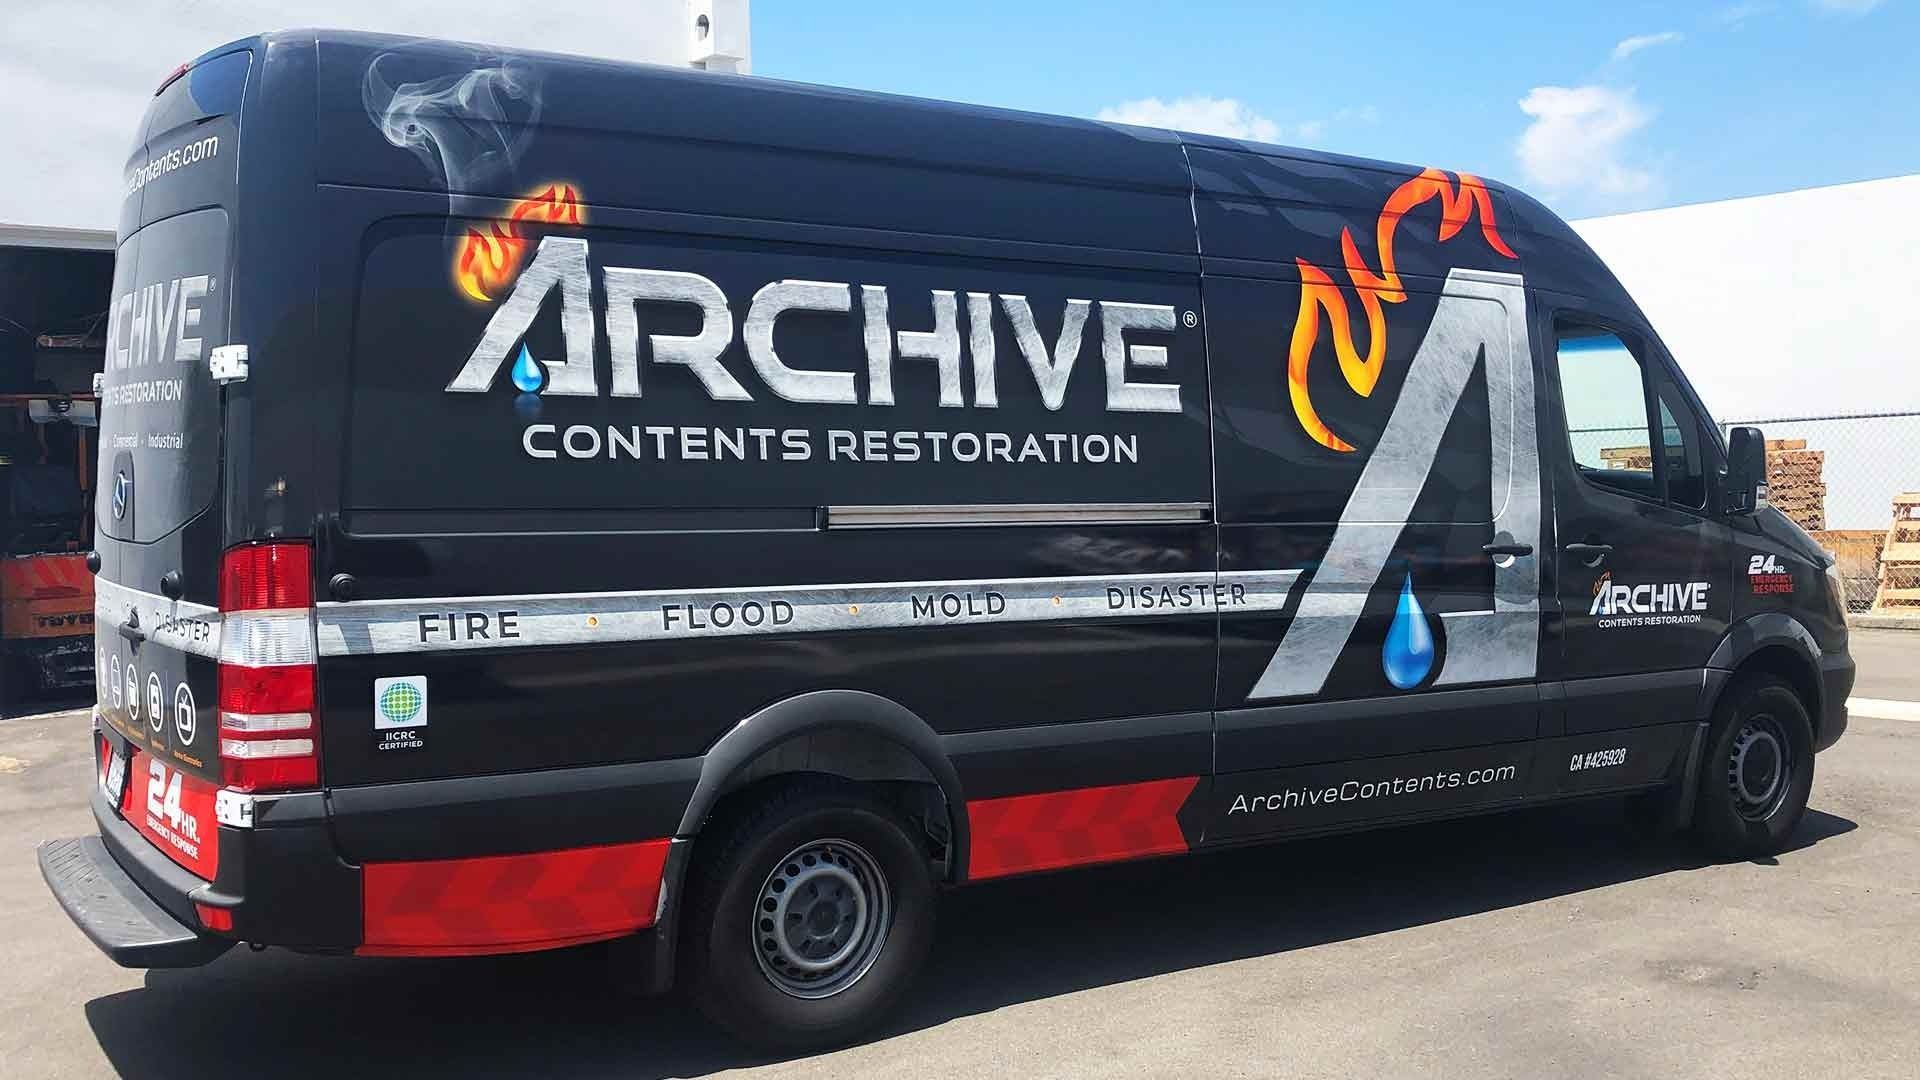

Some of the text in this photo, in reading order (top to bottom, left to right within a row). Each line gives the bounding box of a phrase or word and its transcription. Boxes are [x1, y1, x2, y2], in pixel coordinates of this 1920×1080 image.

[148, 433, 183, 448] Industrial
[522, 424, 1138, 463] CONTENTS RESTORATION
[417, 583, 1247, 643] FIRE FLOOD MOLD DISASTER
[1599, 614, 1701, 628] CONTENTS RESTORATION
[378, 740, 423, 750] CERTIFIED
[385, 730, 416, 741] IICRC
[1570, 748, 1626, 772] CA #425928
[1228, 763, 1516, 816] ArchiveContents.com
